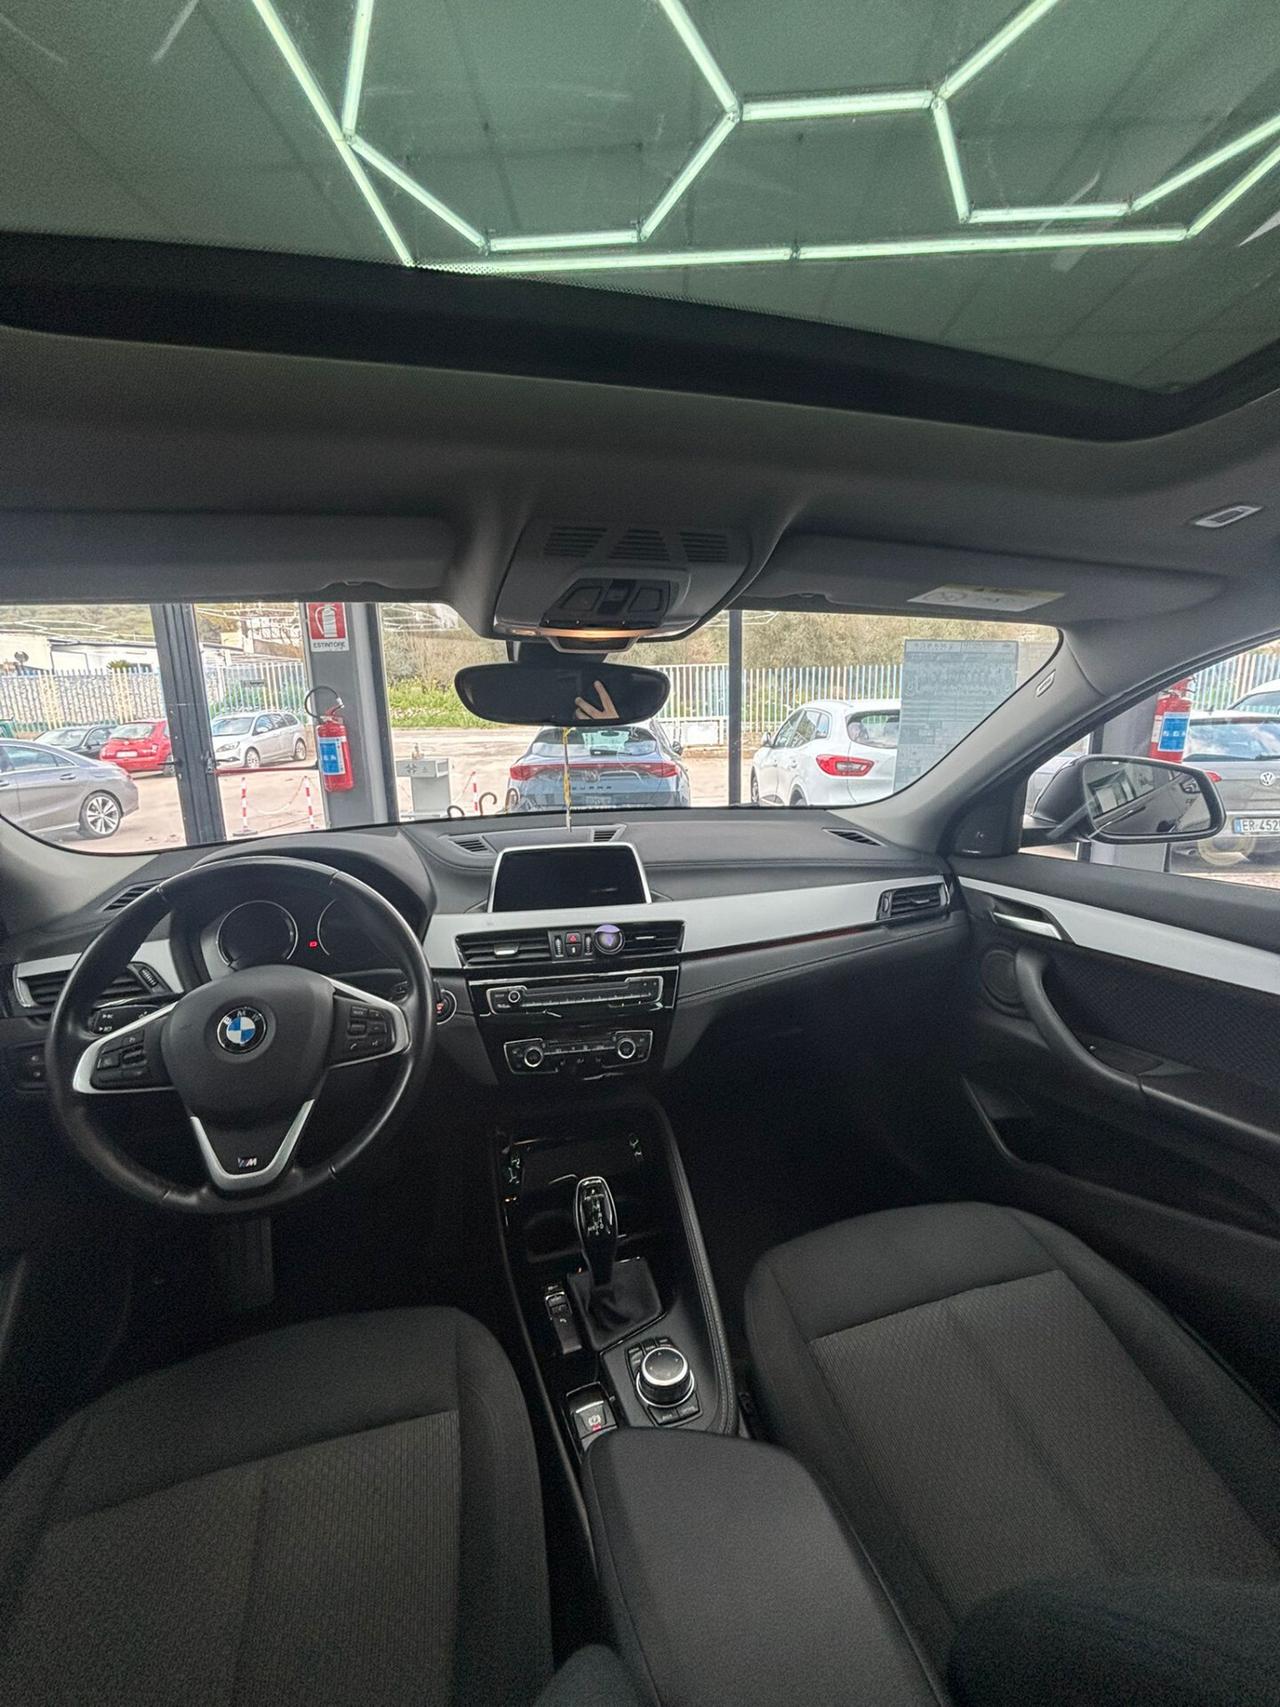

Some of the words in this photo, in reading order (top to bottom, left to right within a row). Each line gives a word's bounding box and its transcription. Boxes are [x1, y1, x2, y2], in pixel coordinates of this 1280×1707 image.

[313, 641, 346, 650] ESTINTORE
[1242, 819, 1255, 831] ER
[1259, 819, 1280, 831] 452
[222, 1010, 261, 1025] BMW
